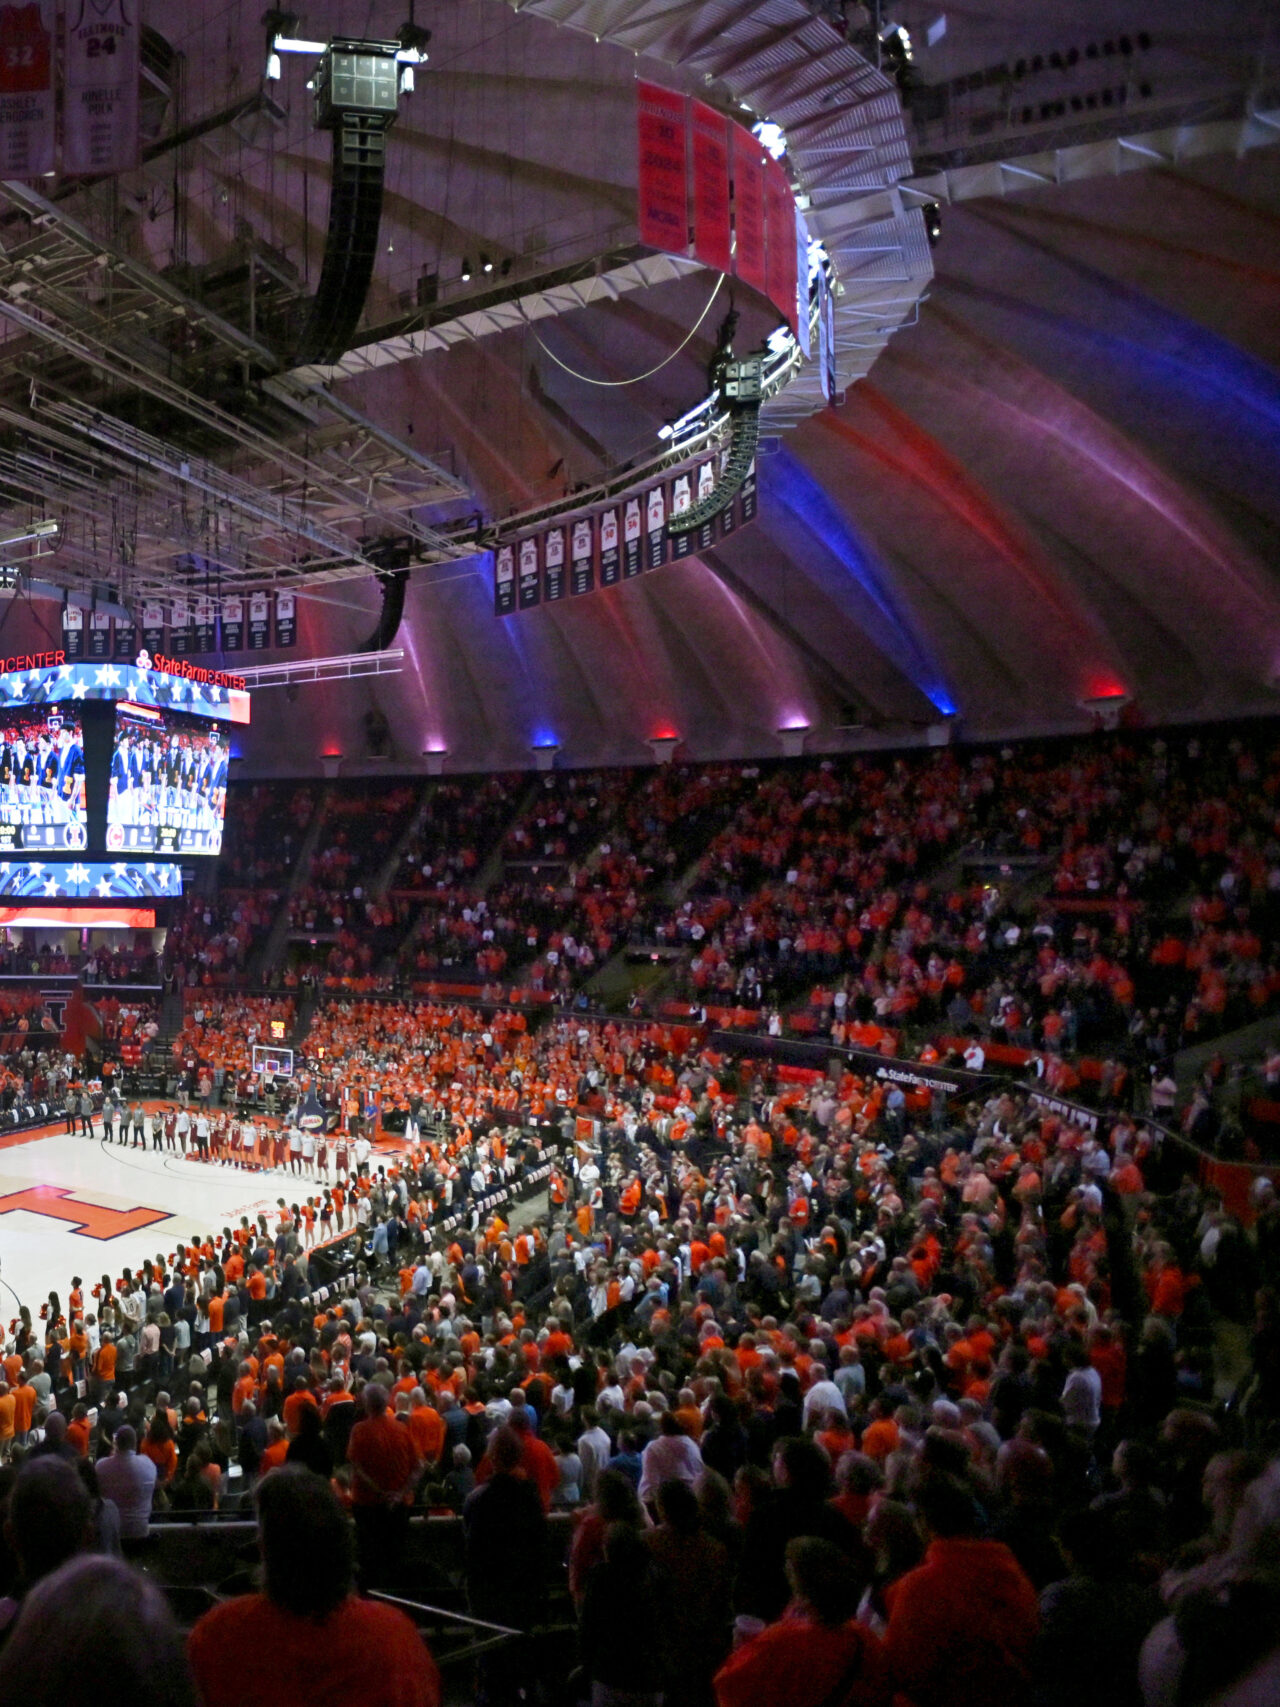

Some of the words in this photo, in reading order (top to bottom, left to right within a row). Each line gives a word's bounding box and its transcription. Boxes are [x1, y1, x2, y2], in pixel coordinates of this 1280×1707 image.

[6, 46, 34, 67] 32
[86, 37, 116, 57] 24
[5, 650, 66, 673] CENTER
[207, 669, 246, 691] CENTER
[272, 1028, 284, 1039] 30
